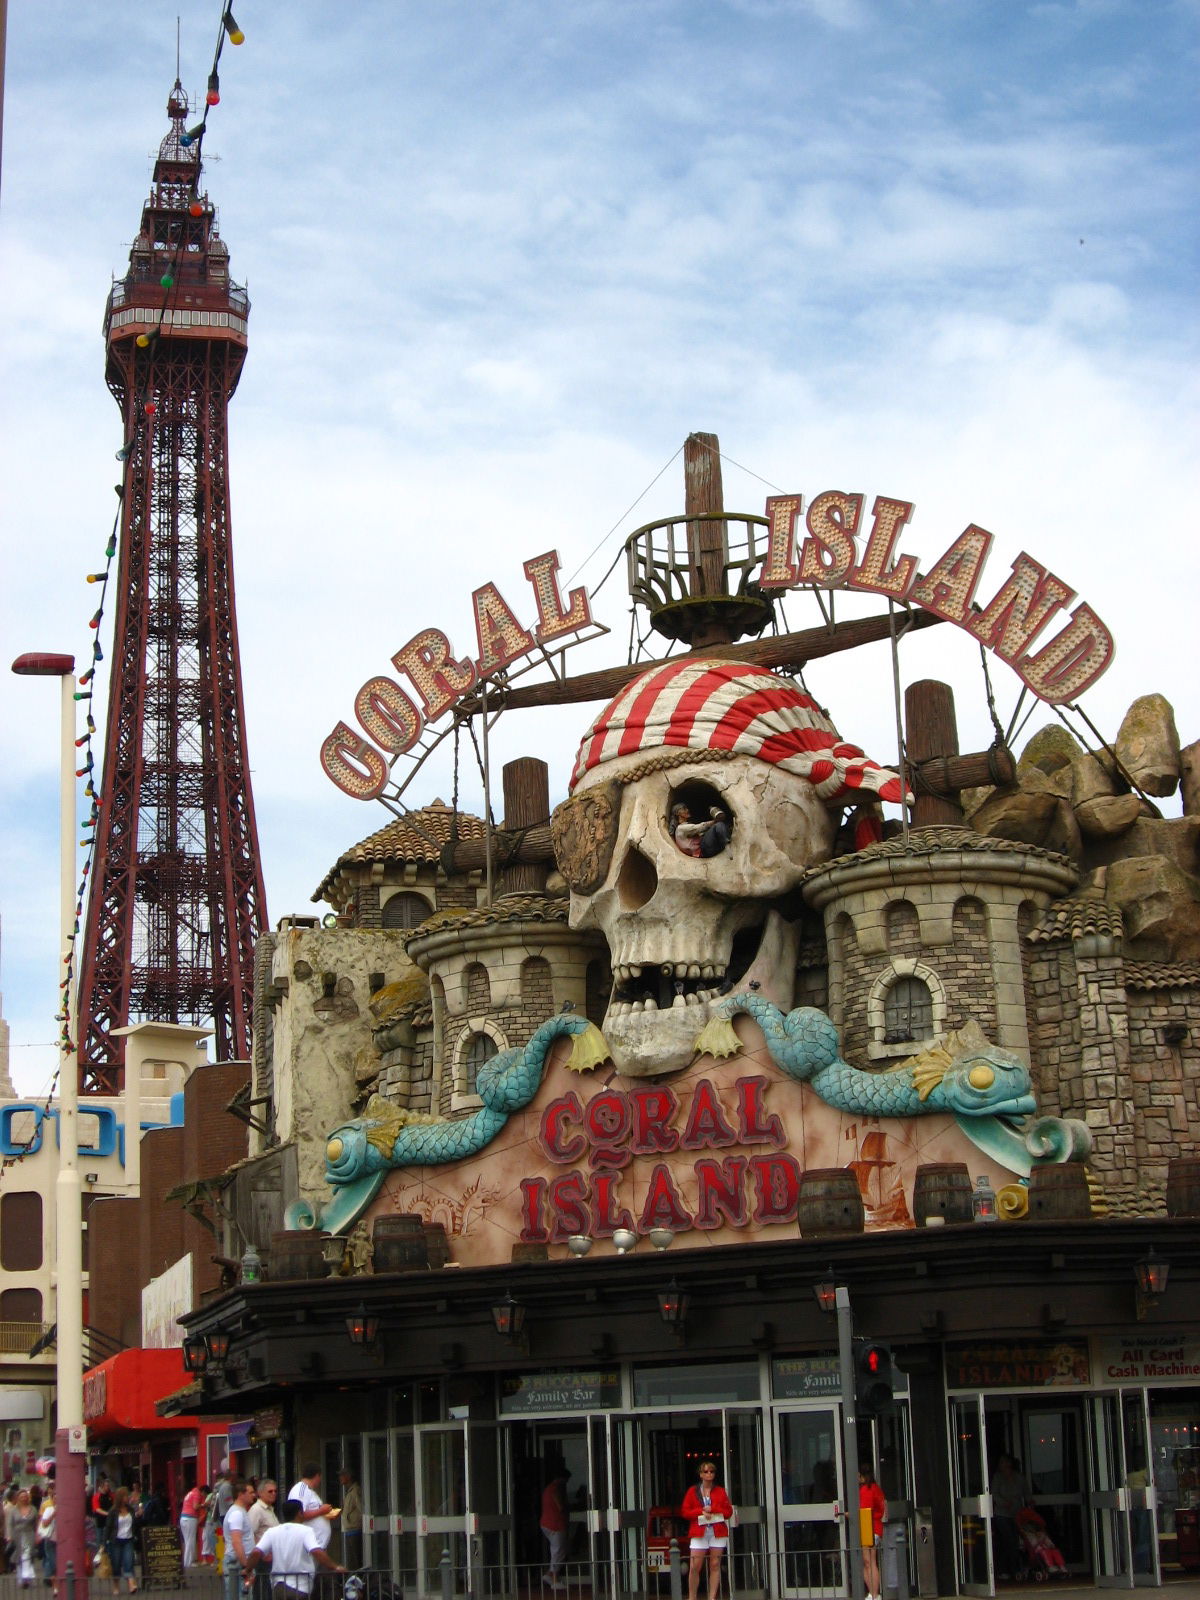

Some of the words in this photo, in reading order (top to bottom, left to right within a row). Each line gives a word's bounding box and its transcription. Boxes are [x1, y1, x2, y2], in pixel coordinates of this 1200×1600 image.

[320, 548, 593, 800] CORAL
[759, 489, 1115, 705] ISLAND
[539, 1075, 787, 1169] CORAL
[519, 1152, 800, 1243] ISLAND
[1122, 1349, 1143, 1362] All
[1150, 1347, 1184, 1361] Card
[1107, 1364, 1139, 1378] Cash
[804, 1374, 841, 1389] Famil
[527, 1390, 569, 1405] Family
[572, 1389, 595, 1400] Bar
